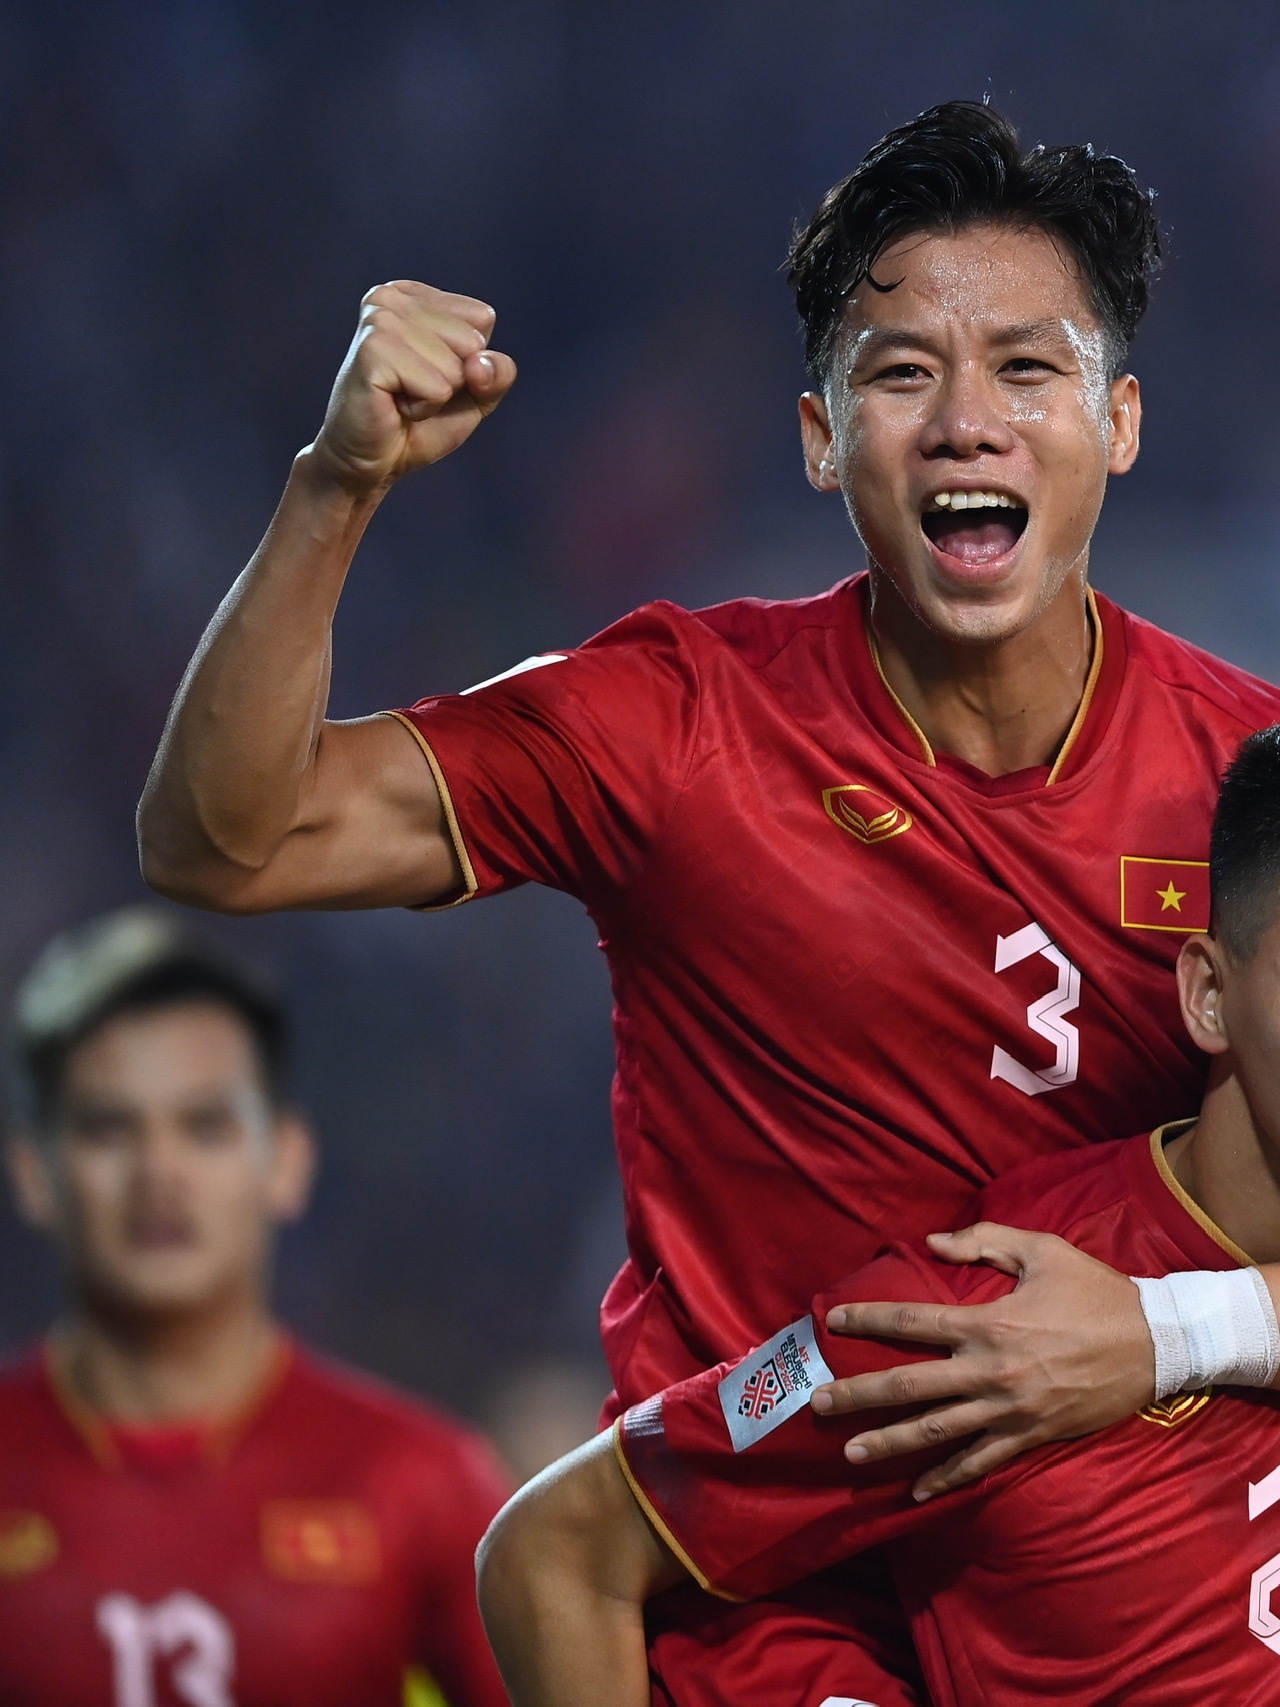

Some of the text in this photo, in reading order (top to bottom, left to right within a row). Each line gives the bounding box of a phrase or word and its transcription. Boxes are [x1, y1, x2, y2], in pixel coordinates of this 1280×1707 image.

[991, 921, 1081, 1096] 3
[775, 1352, 794, 1394] CUP 2022
[780, 1341, 803, 1391] ELECTRIC
[786, 1333, 812, 1390] MITSUBISHI
[799, 1345, 810, 1364] AFF
[95, 1590, 236, 1707] 13
